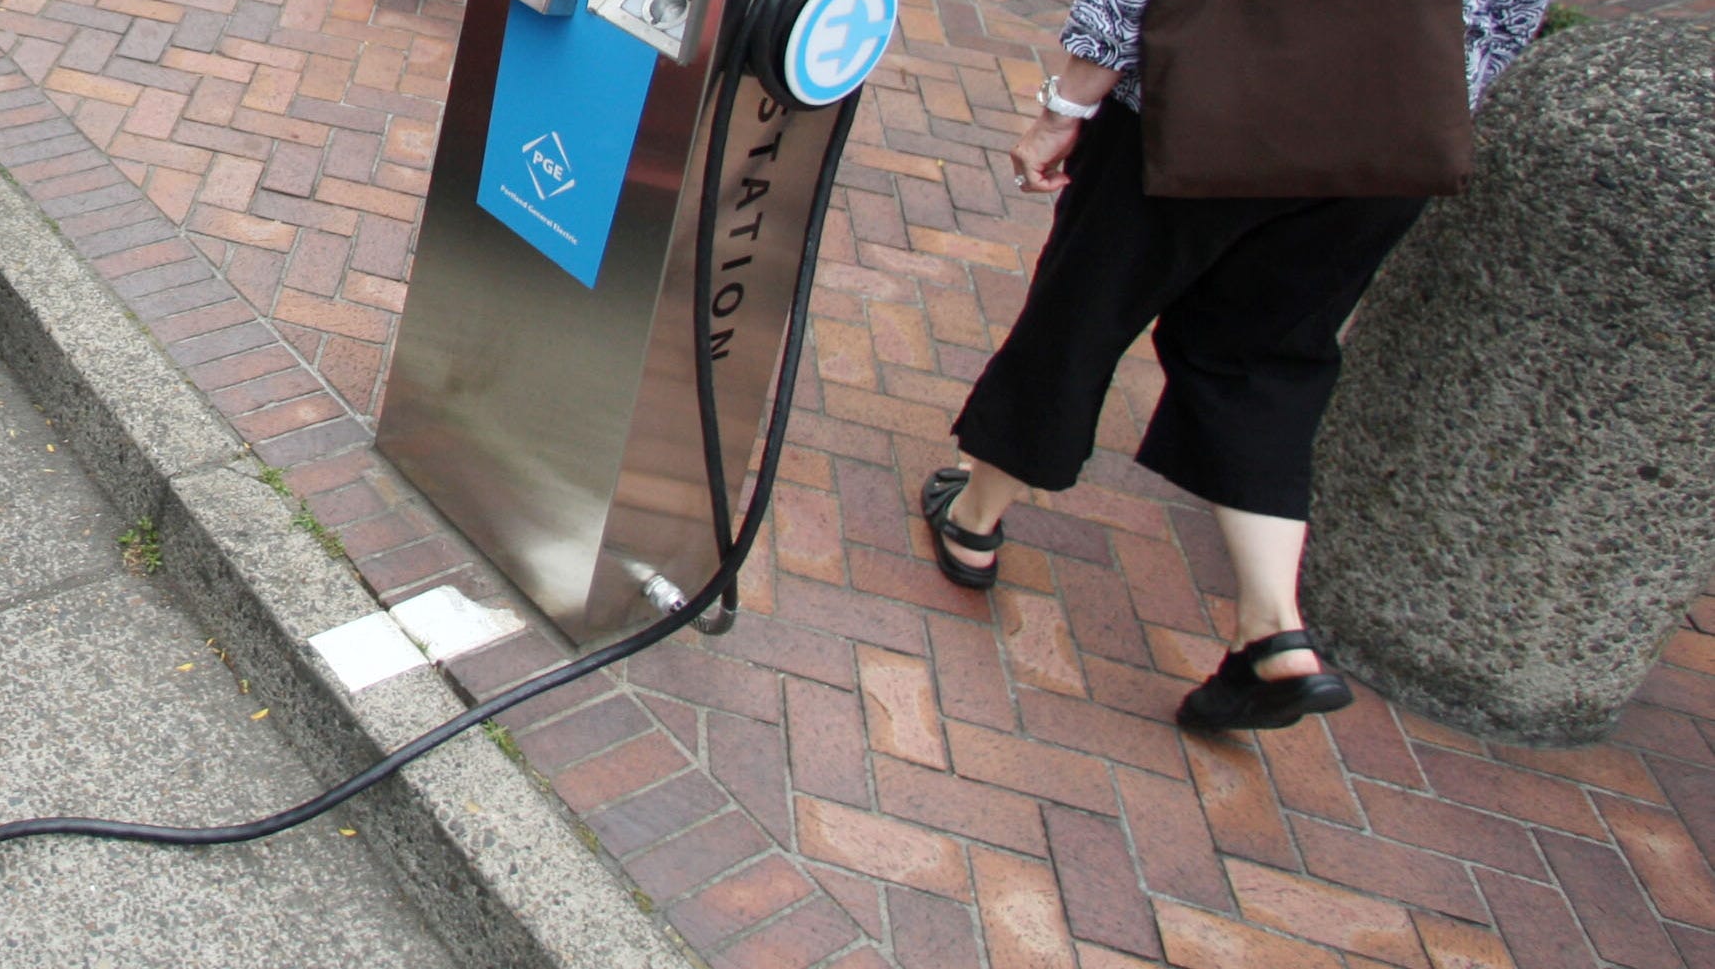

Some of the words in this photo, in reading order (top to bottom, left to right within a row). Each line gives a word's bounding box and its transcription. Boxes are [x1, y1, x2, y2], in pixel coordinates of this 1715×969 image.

[533, 150, 564, 182] PGE
[500, 184, 528, 209] Portland
[553, 222, 578, 246] Electric
